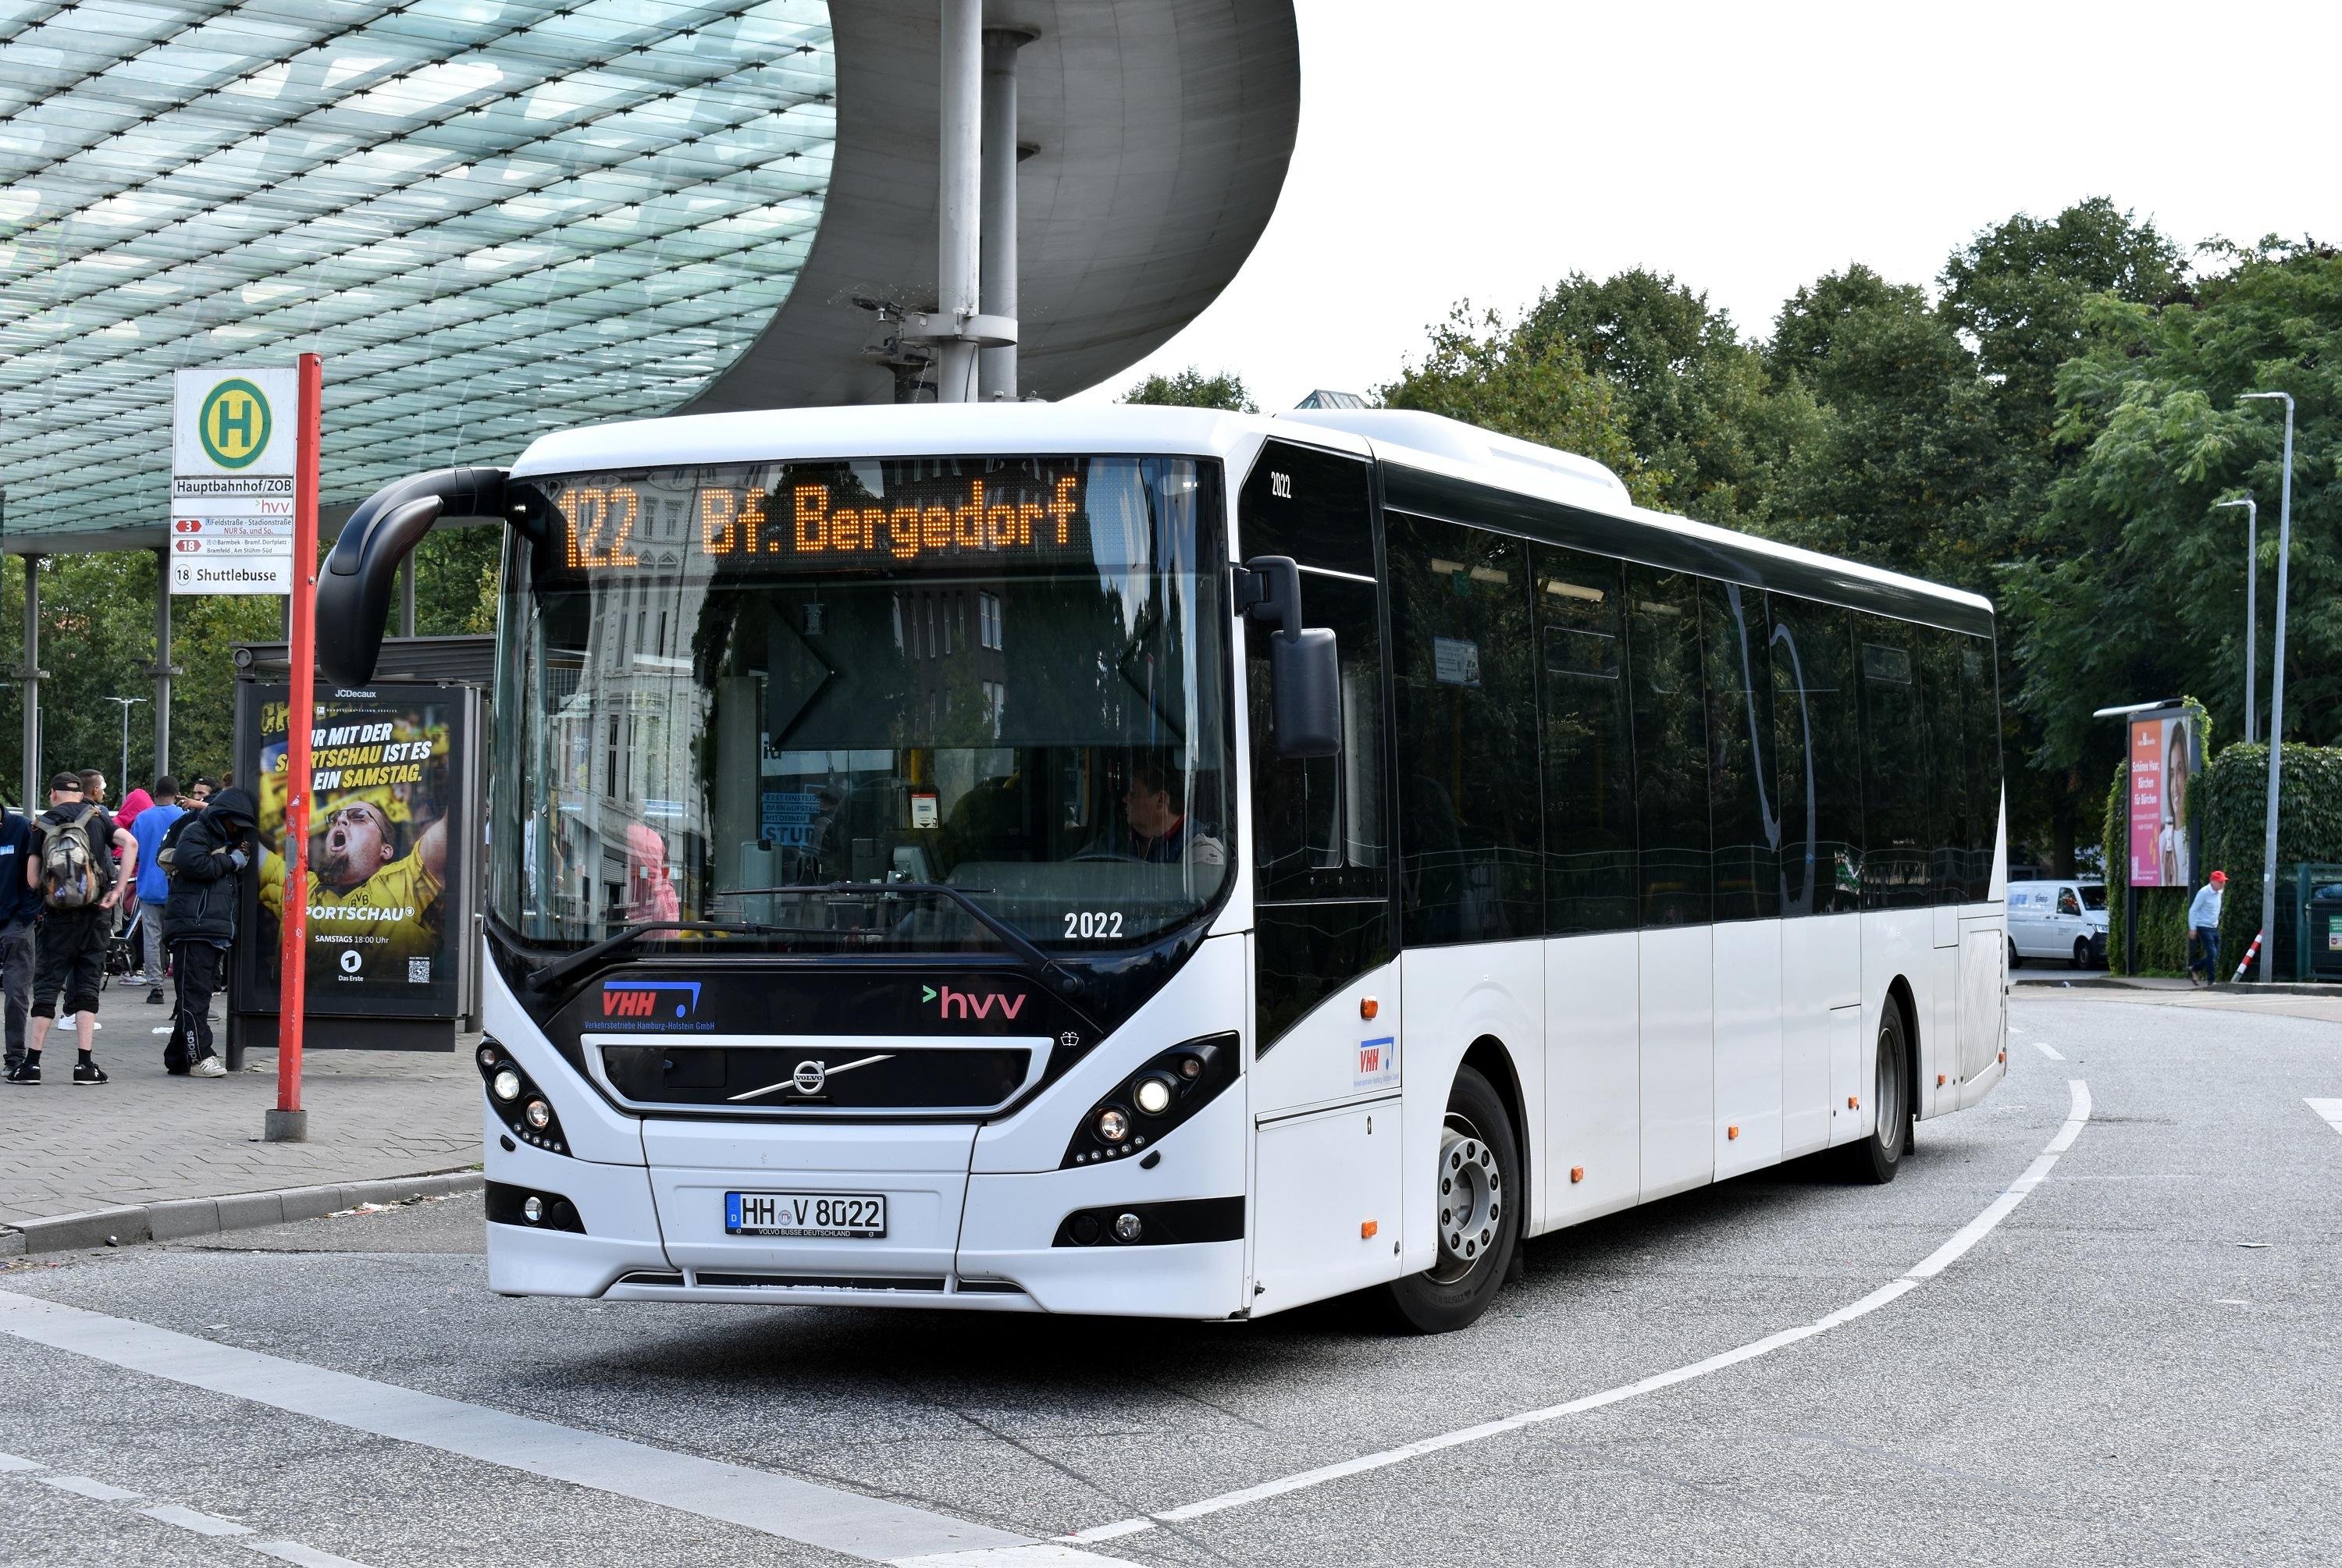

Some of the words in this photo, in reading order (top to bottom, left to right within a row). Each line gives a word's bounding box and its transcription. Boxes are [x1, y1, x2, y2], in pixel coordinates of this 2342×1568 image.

[219, 400, 251, 447] H
[177, 480, 291, 494] Hauptbahnhof/ZOB
[1271, 471, 1291, 498] 2022
[186, 521, 193, 532] 3
[558, 489, 638, 567] 122
[702, 487, 778, 555] Bf.
[795, 476, 1077, 558] Bergedorf
[183, 541, 195, 551] 18
[176, 570, 190, 580] 18
[197, 568, 276, 581] Shuttlebusse
[335, 689, 376, 698] JCDecaux
[328, 725, 360, 747] MIT
[360, 723, 393, 743] DER
[275, 745, 382, 773] SRTSCHAU
[383, 742, 411, 763] IST
[410, 741, 432, 760] ES
[313, 770, 342, 791] EIN
[342, 763, 422, 788] SAMSTAG.
[351, 892, 369, 908] BVB
[306, 906, 404, 921] PORTSCHAU
[1064, 912, 1123, 938] 2022
[603, 991, 657, 1016] VHH
[585, 1021, 635, 1029] Verkehrsbetriebe
[637, 1022, 694, 1030] Hamburg-Holstein
[1361, 1048, 1379, 1072] VHH
[742, 1198, 774, 1225] HH
[793, 1199, 809, 1225] V
[816, 1200, 880, 1227] 8022
